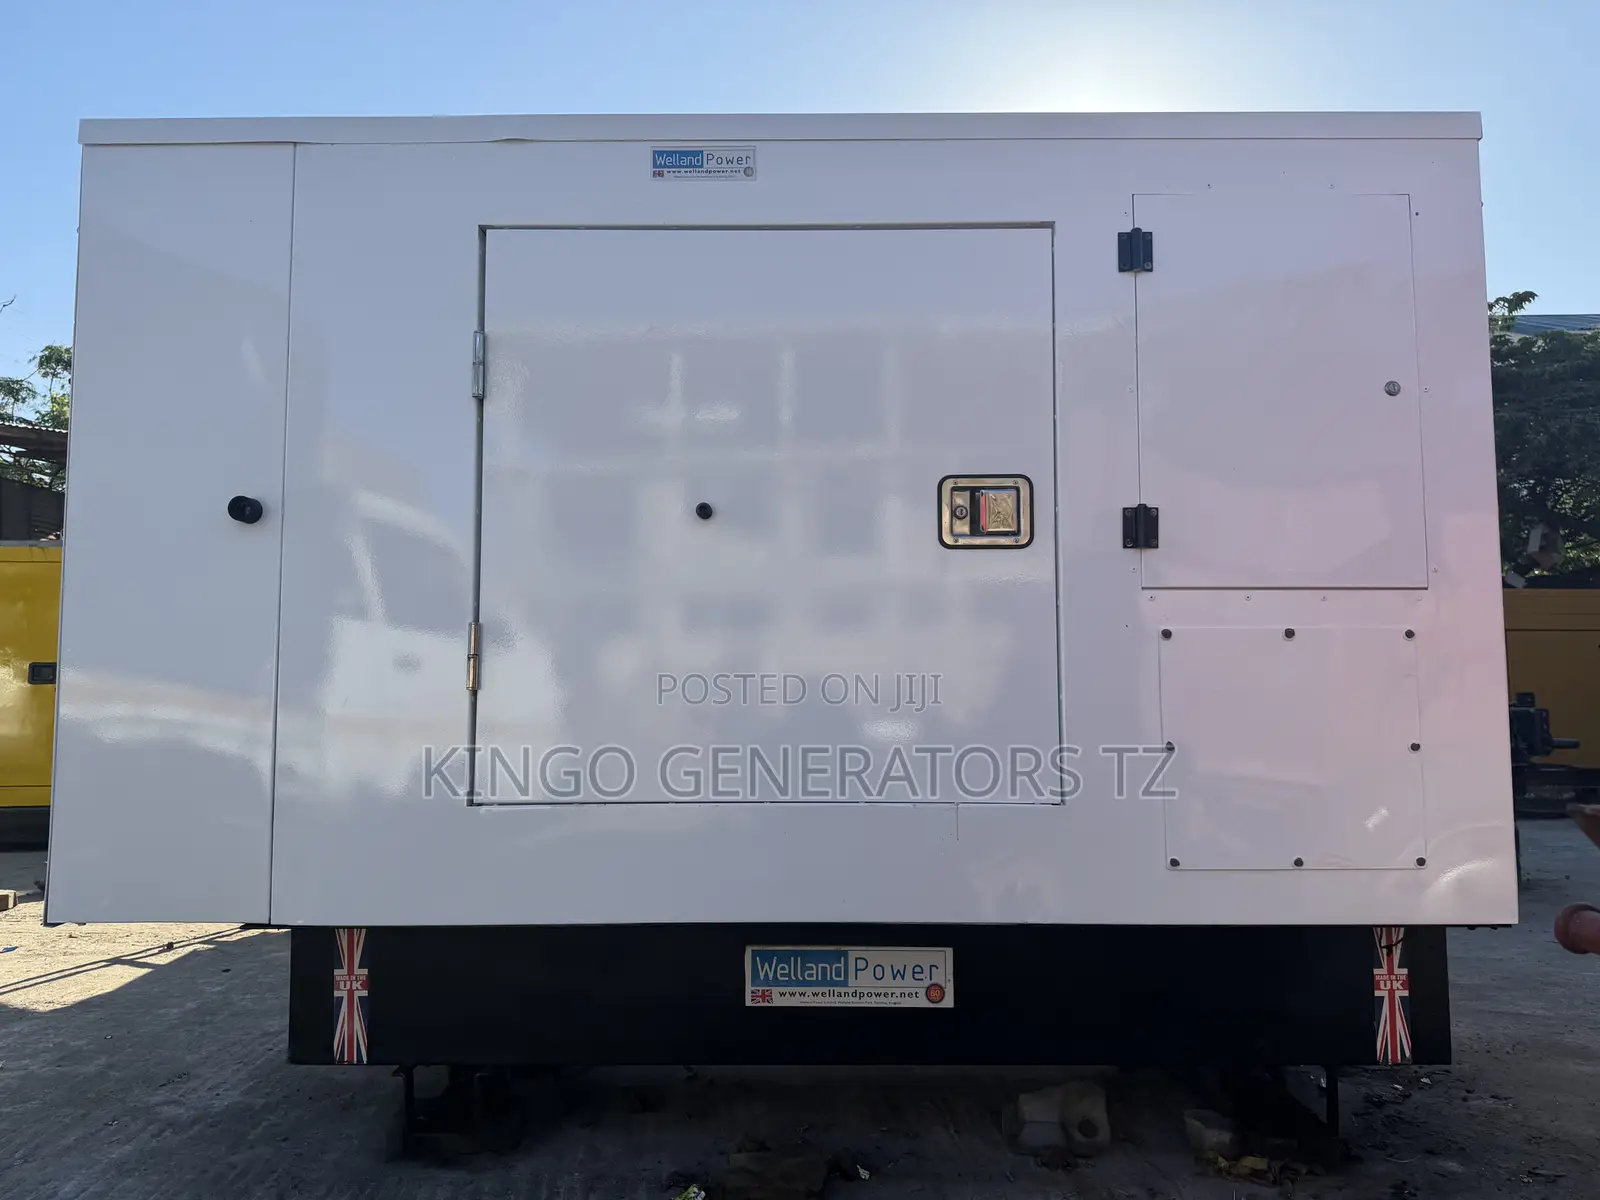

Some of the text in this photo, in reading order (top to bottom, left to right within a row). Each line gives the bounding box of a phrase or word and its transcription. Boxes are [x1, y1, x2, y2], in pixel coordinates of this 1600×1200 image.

[655, 153, 751, 166] Welland Power
[756, 956, 939, 981] Welland Power
[339, 981, 363, 990] UK
[1379, 980, 1404, 990] UK
[778, 989, 920, 1000] www.wellandpower.net
